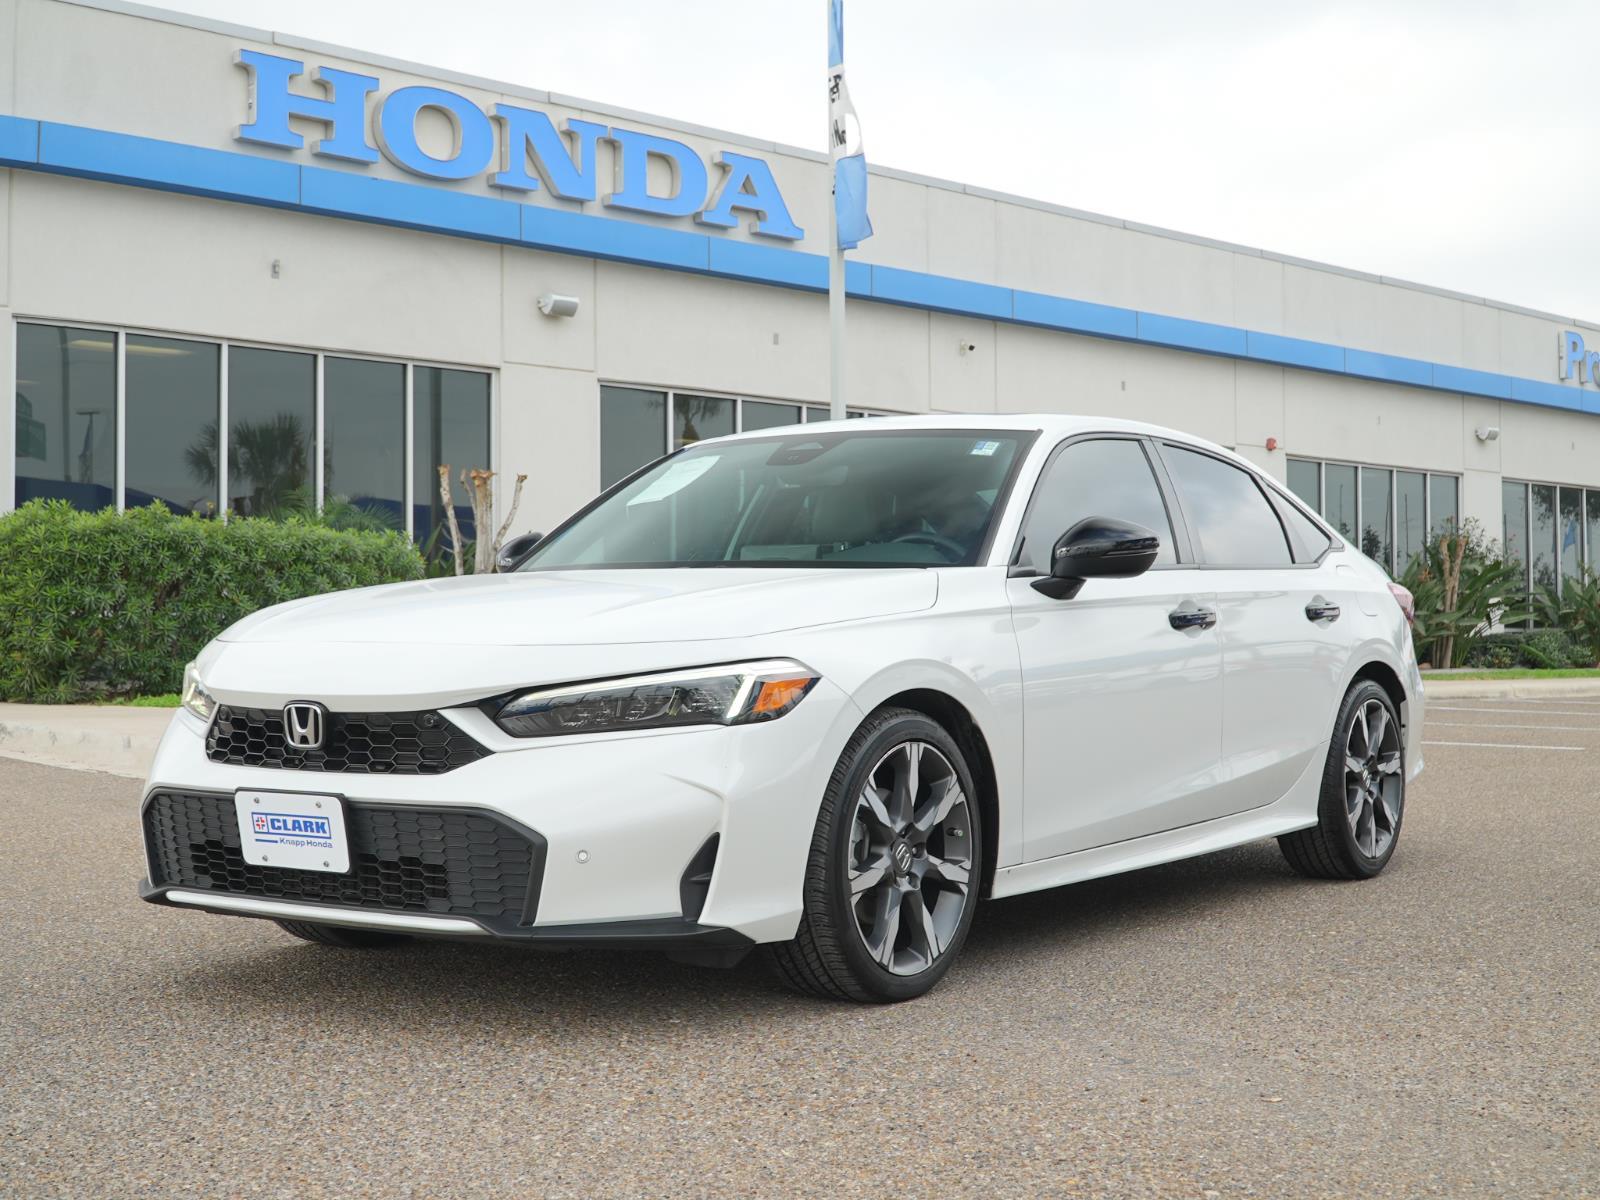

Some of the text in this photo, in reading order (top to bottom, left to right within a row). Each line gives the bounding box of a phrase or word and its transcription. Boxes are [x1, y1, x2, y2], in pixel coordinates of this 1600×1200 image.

[233, 49, 804, 241] HONDA
[1559, 330, 1600, 389] Pr
[270, 818, 327, 834] CLARK
[280, 838, 333, 848] Knapp Honda
